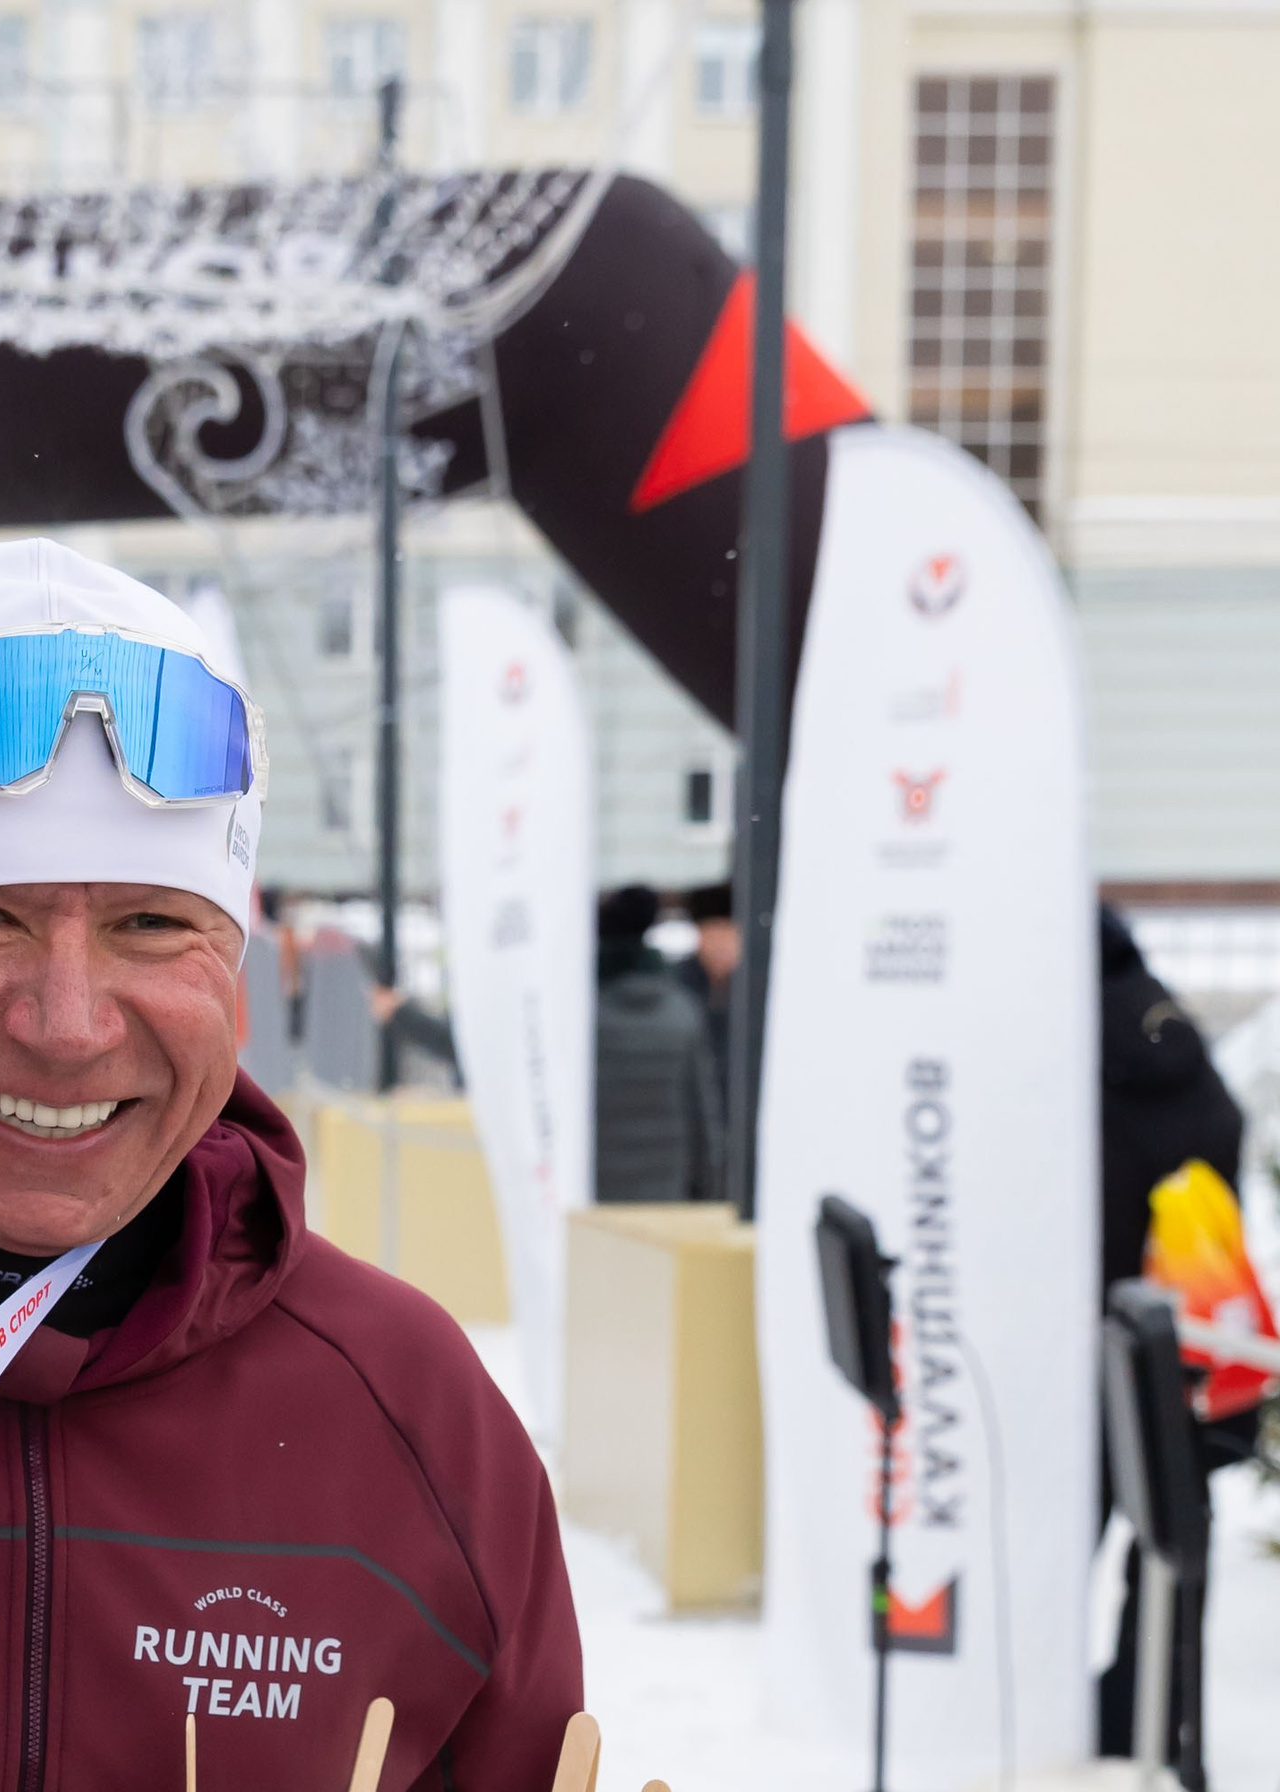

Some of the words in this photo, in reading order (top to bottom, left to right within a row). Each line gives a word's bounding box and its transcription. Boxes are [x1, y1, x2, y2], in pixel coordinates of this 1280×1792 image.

[234, 822, 250, 851] IRON
[9, 1281, 53, 1334] СПОРТ
[193, 1586, 243, 1612] WORLD
[247, 1588, 288, 1618] CLASS
[133, 1625, 342, 1675] RUNNING
[182, 1676, 302, 1720] TEAM
